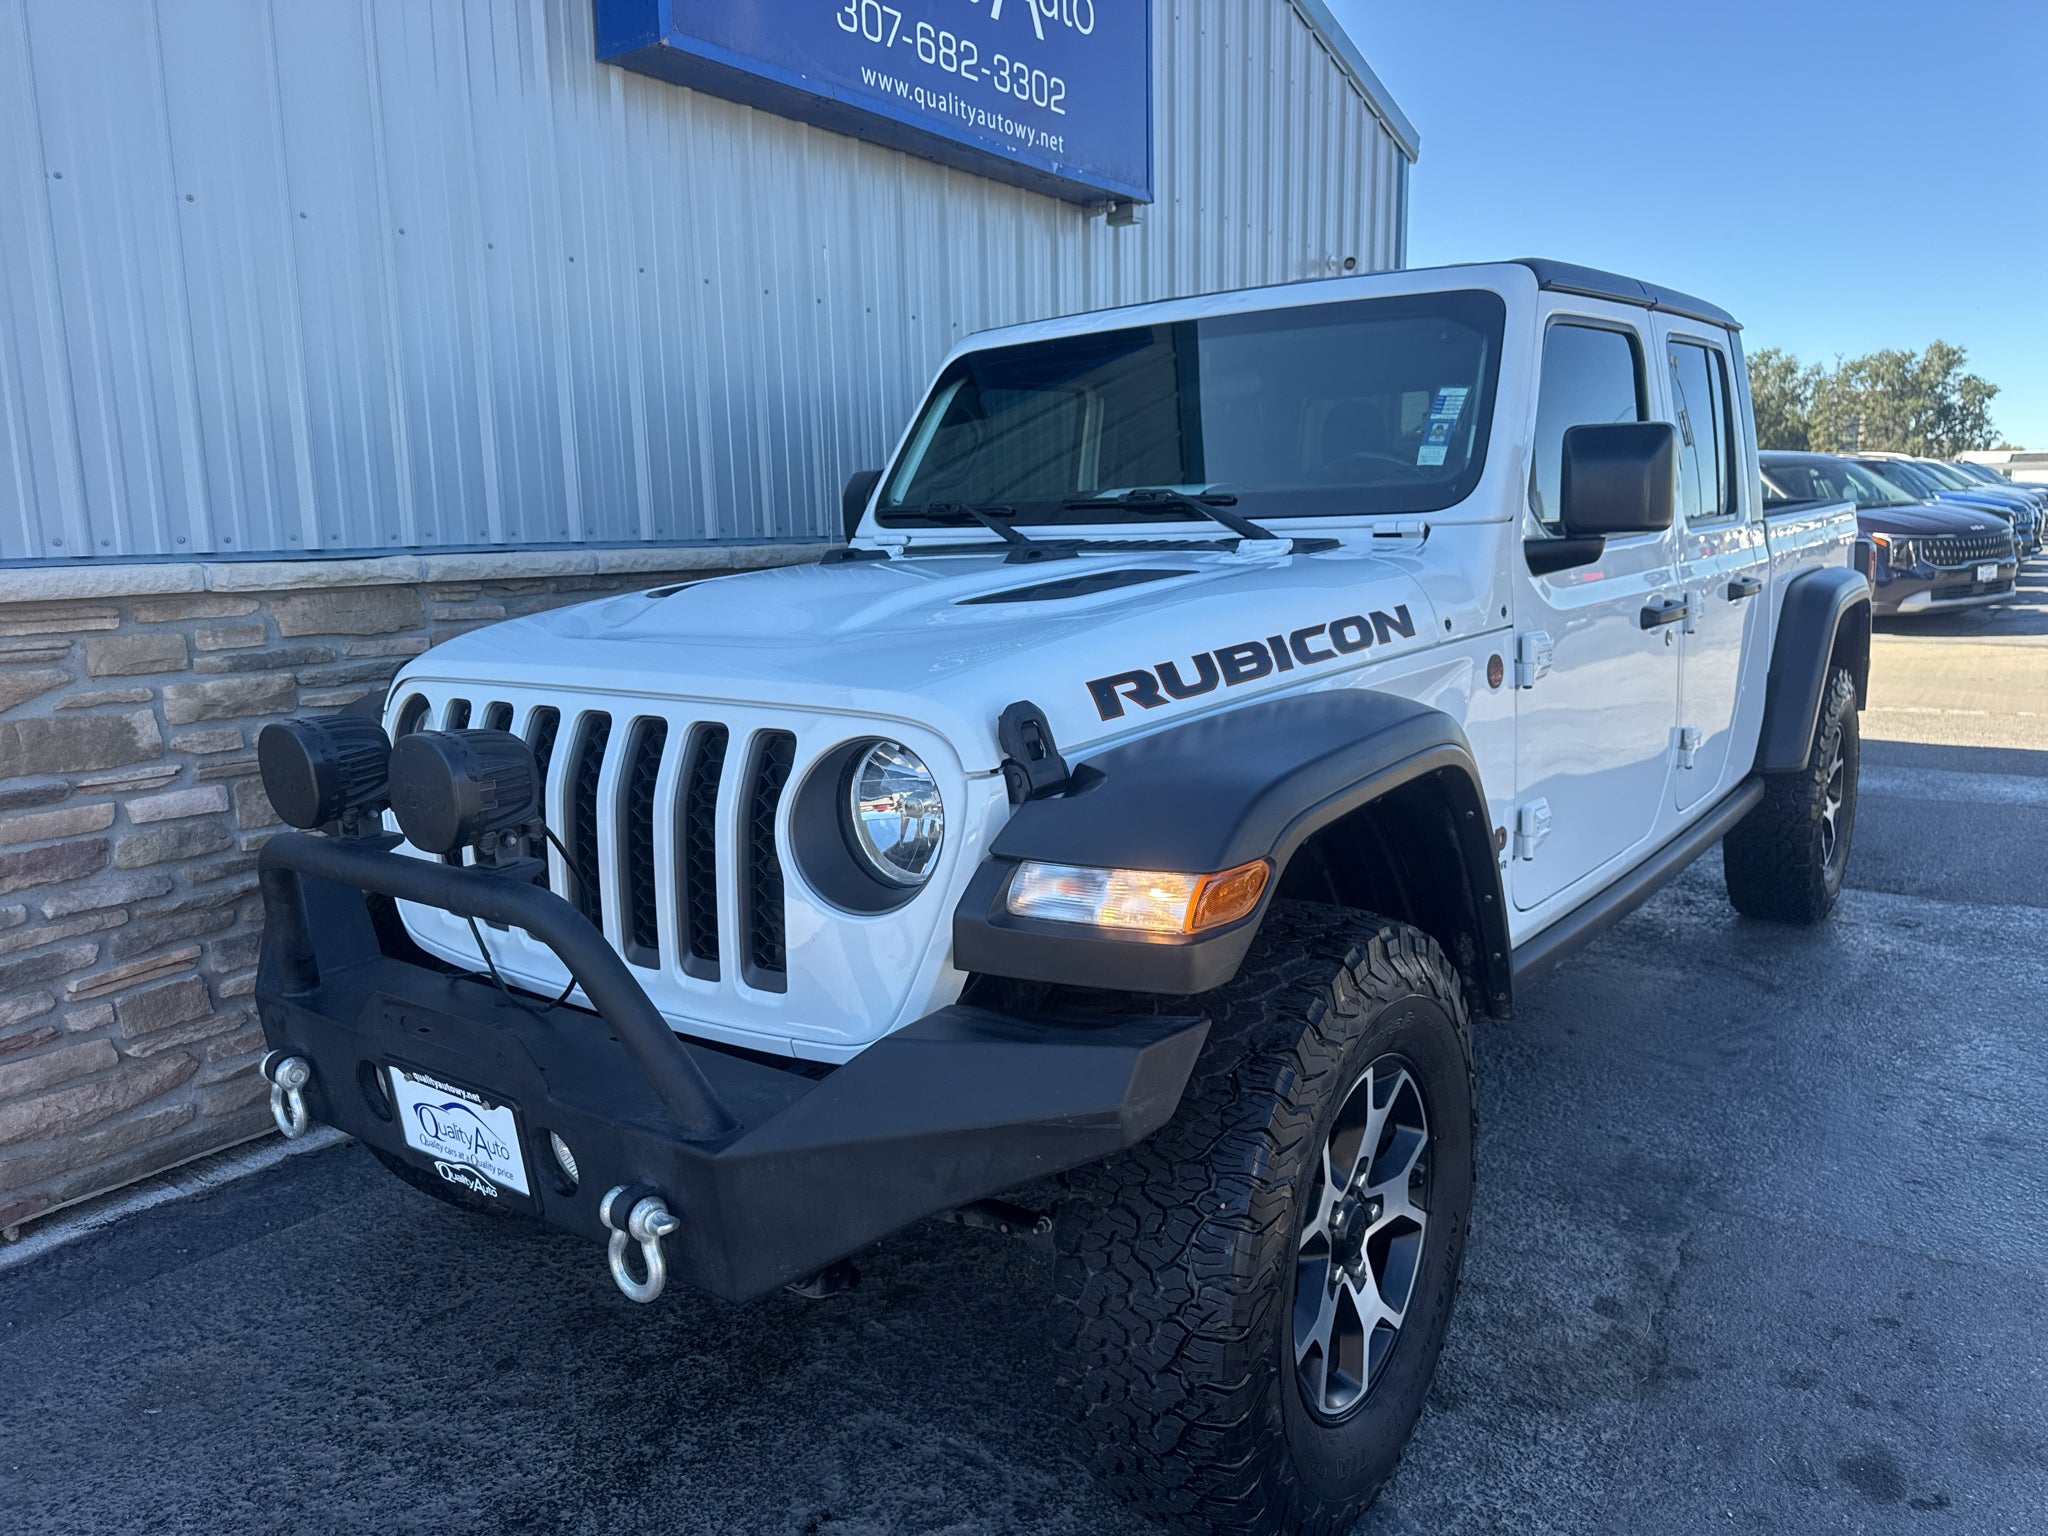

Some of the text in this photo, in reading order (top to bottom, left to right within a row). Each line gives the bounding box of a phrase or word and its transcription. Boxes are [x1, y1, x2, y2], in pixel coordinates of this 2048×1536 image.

[836, 0, 1066, 116] 307-682-3302
[861, 66, 1065, 155] www.qualityautowy.net
[1086, 604, 1416, 722] RUBICON
[419, 1133, 444, 1152] Quality
[444, 1146, 458, 1156] cars
[457, 1151, 466, 1160] at
[470, 1154, 497, 1175] Quality
[497, 1168, 514, 1181] price
